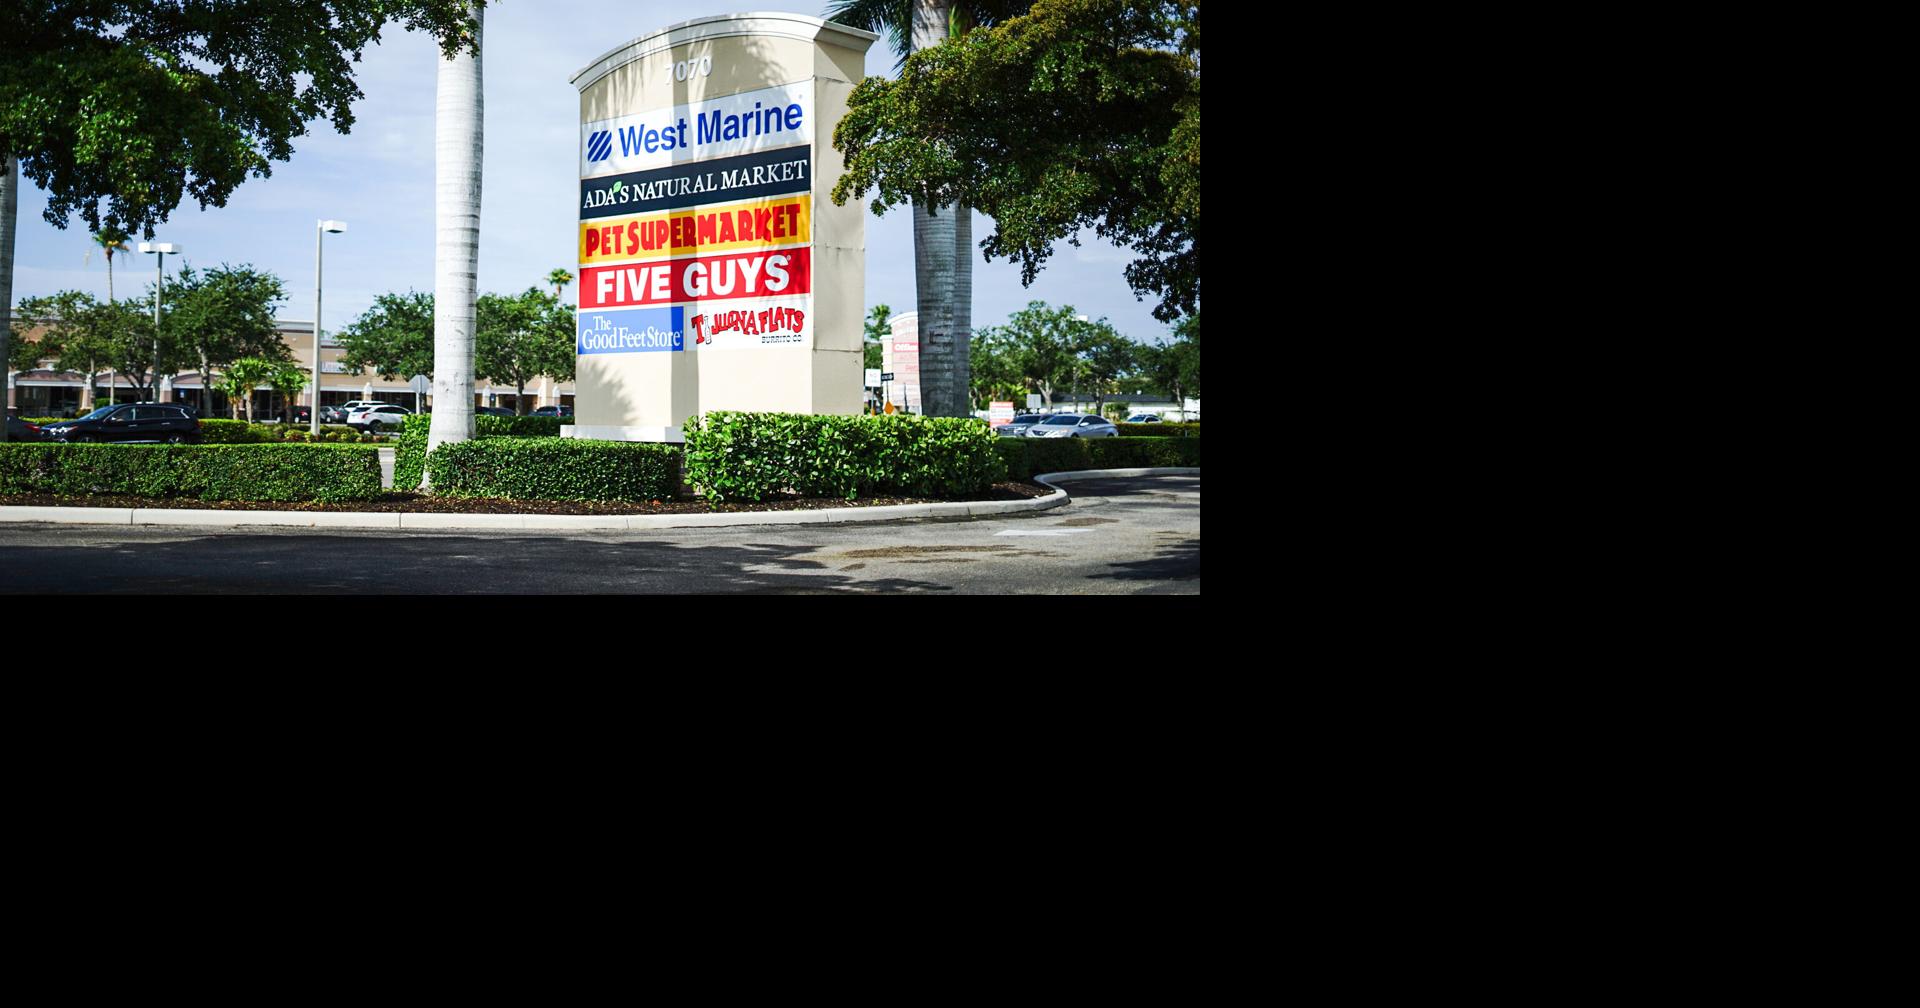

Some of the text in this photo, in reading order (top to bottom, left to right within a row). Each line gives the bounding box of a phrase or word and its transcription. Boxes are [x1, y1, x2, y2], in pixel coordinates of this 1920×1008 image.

[664, 55, 712, 86] 7070
[618, 102, 802, 157] West Marine
[632, 173, 717, 201] NATURAL
[720, 159, 808, 190] MARKET
[586, 203, 800, 257] PET SUPERMARKET
[596, 254, 791, 304] FIVE GUYS
[593, 315, 612, 331] The
[758, 306, 805, 333] FLATS
[582, 326, 681, 350] Good Feet Store
[761, 335, 791, 343] BURRITO
